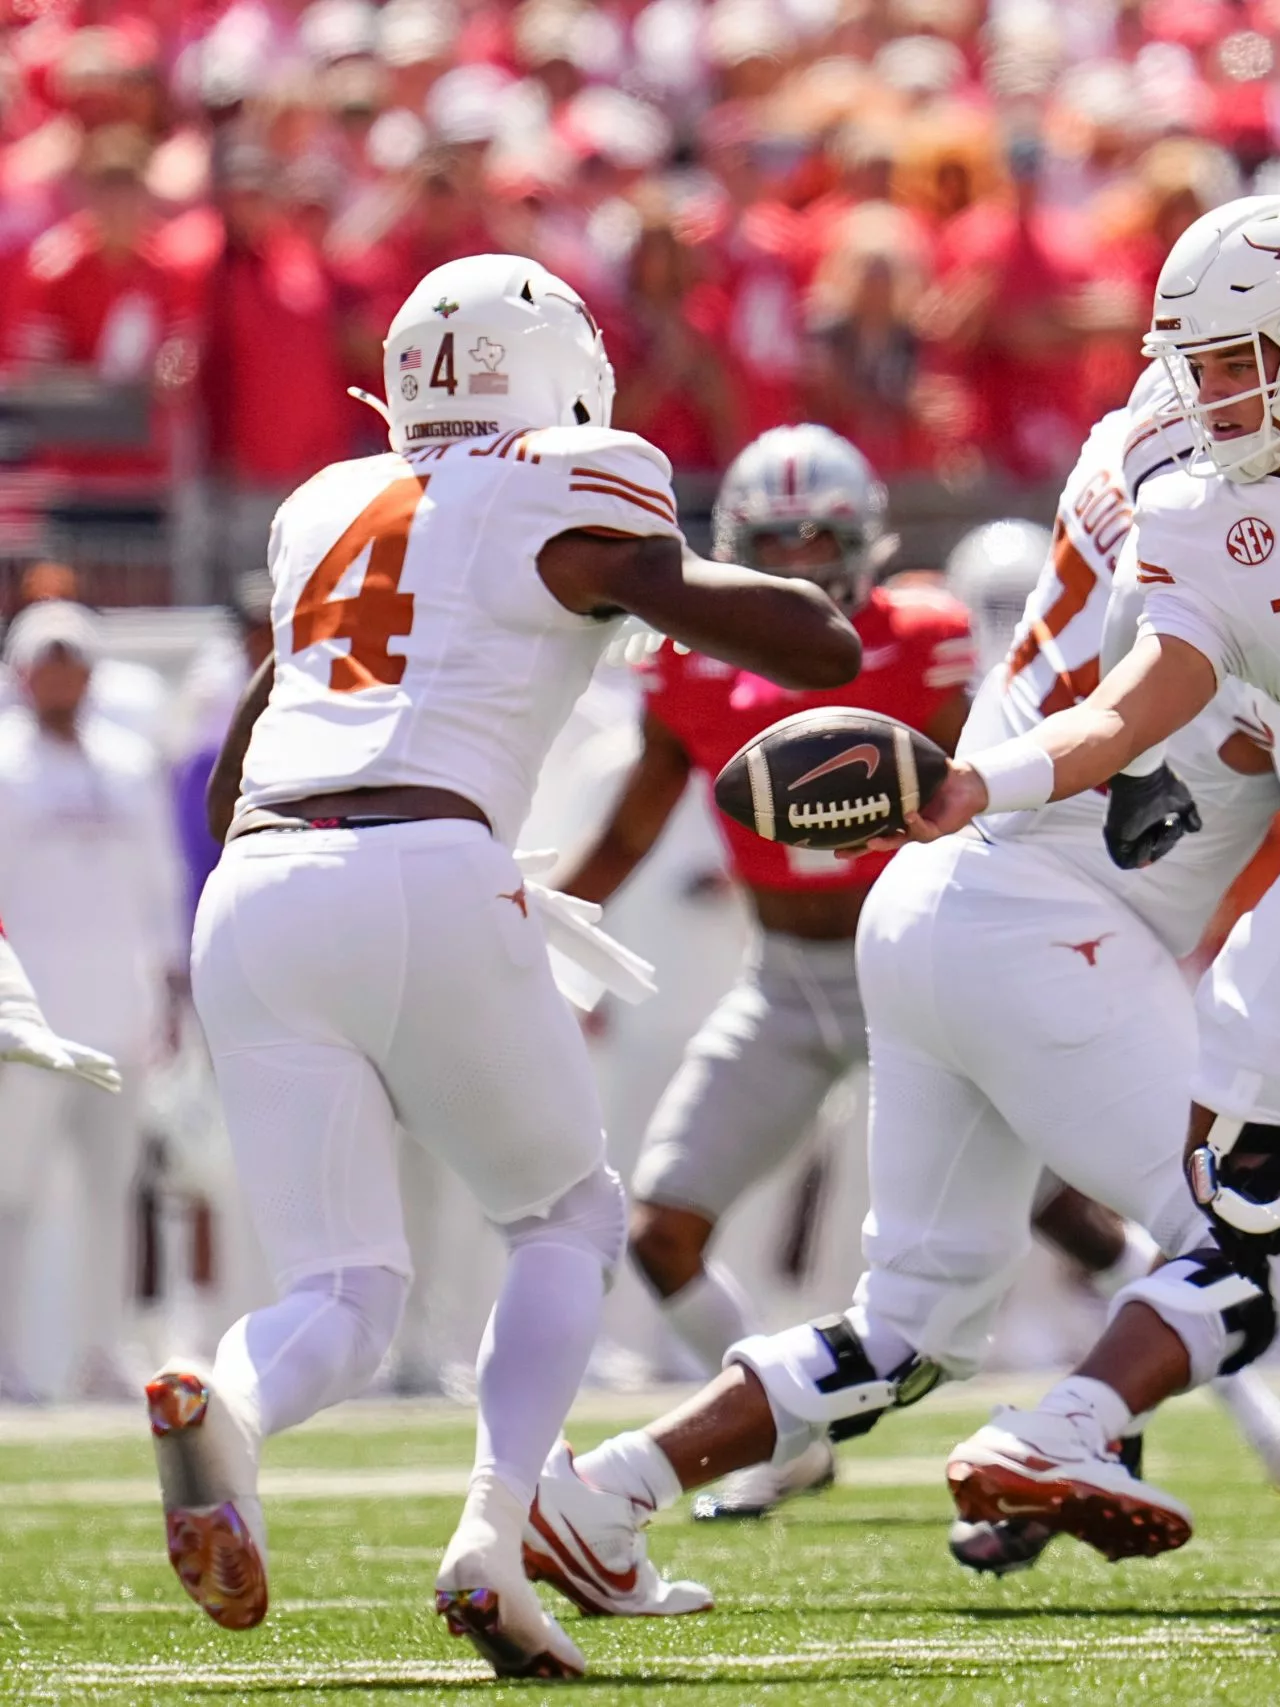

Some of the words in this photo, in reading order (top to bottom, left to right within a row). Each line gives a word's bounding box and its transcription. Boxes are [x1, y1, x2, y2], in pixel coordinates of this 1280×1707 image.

[429, 332, 458, 397] 4
[1226, 516, 1275, 566] SEC
[291, 474, 432, 694] 4
